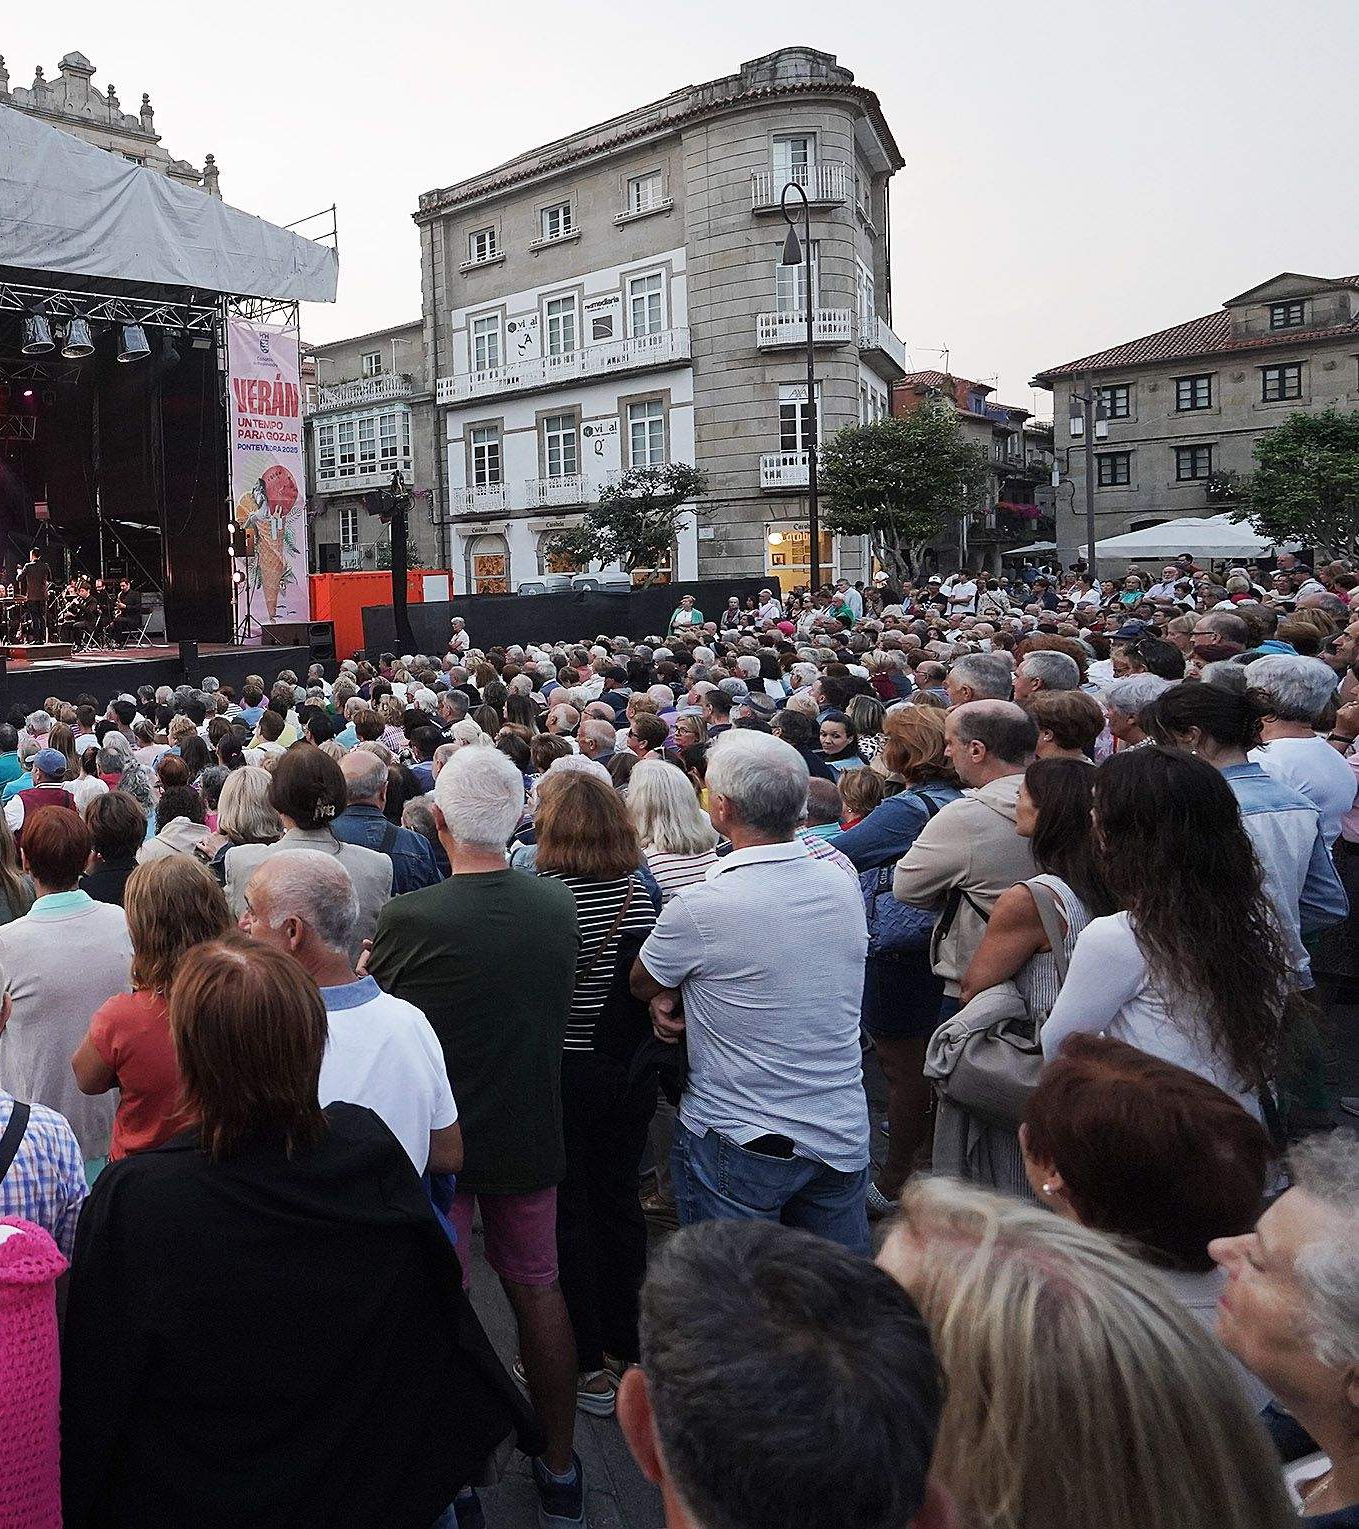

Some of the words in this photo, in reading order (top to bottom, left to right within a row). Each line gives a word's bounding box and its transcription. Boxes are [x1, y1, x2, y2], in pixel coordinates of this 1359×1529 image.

[233, 373, 299, 417] VERÁN
[789, 385, 808, 398] AXA
[237, 418, 252, 428] UN
[252, 419, 283, 431] TEMPO
[237, 430, 266, 440] PARA
[266, 431, 298, 442] GOZAR
[237, 443, 282, 452] PONTEVEDRA
